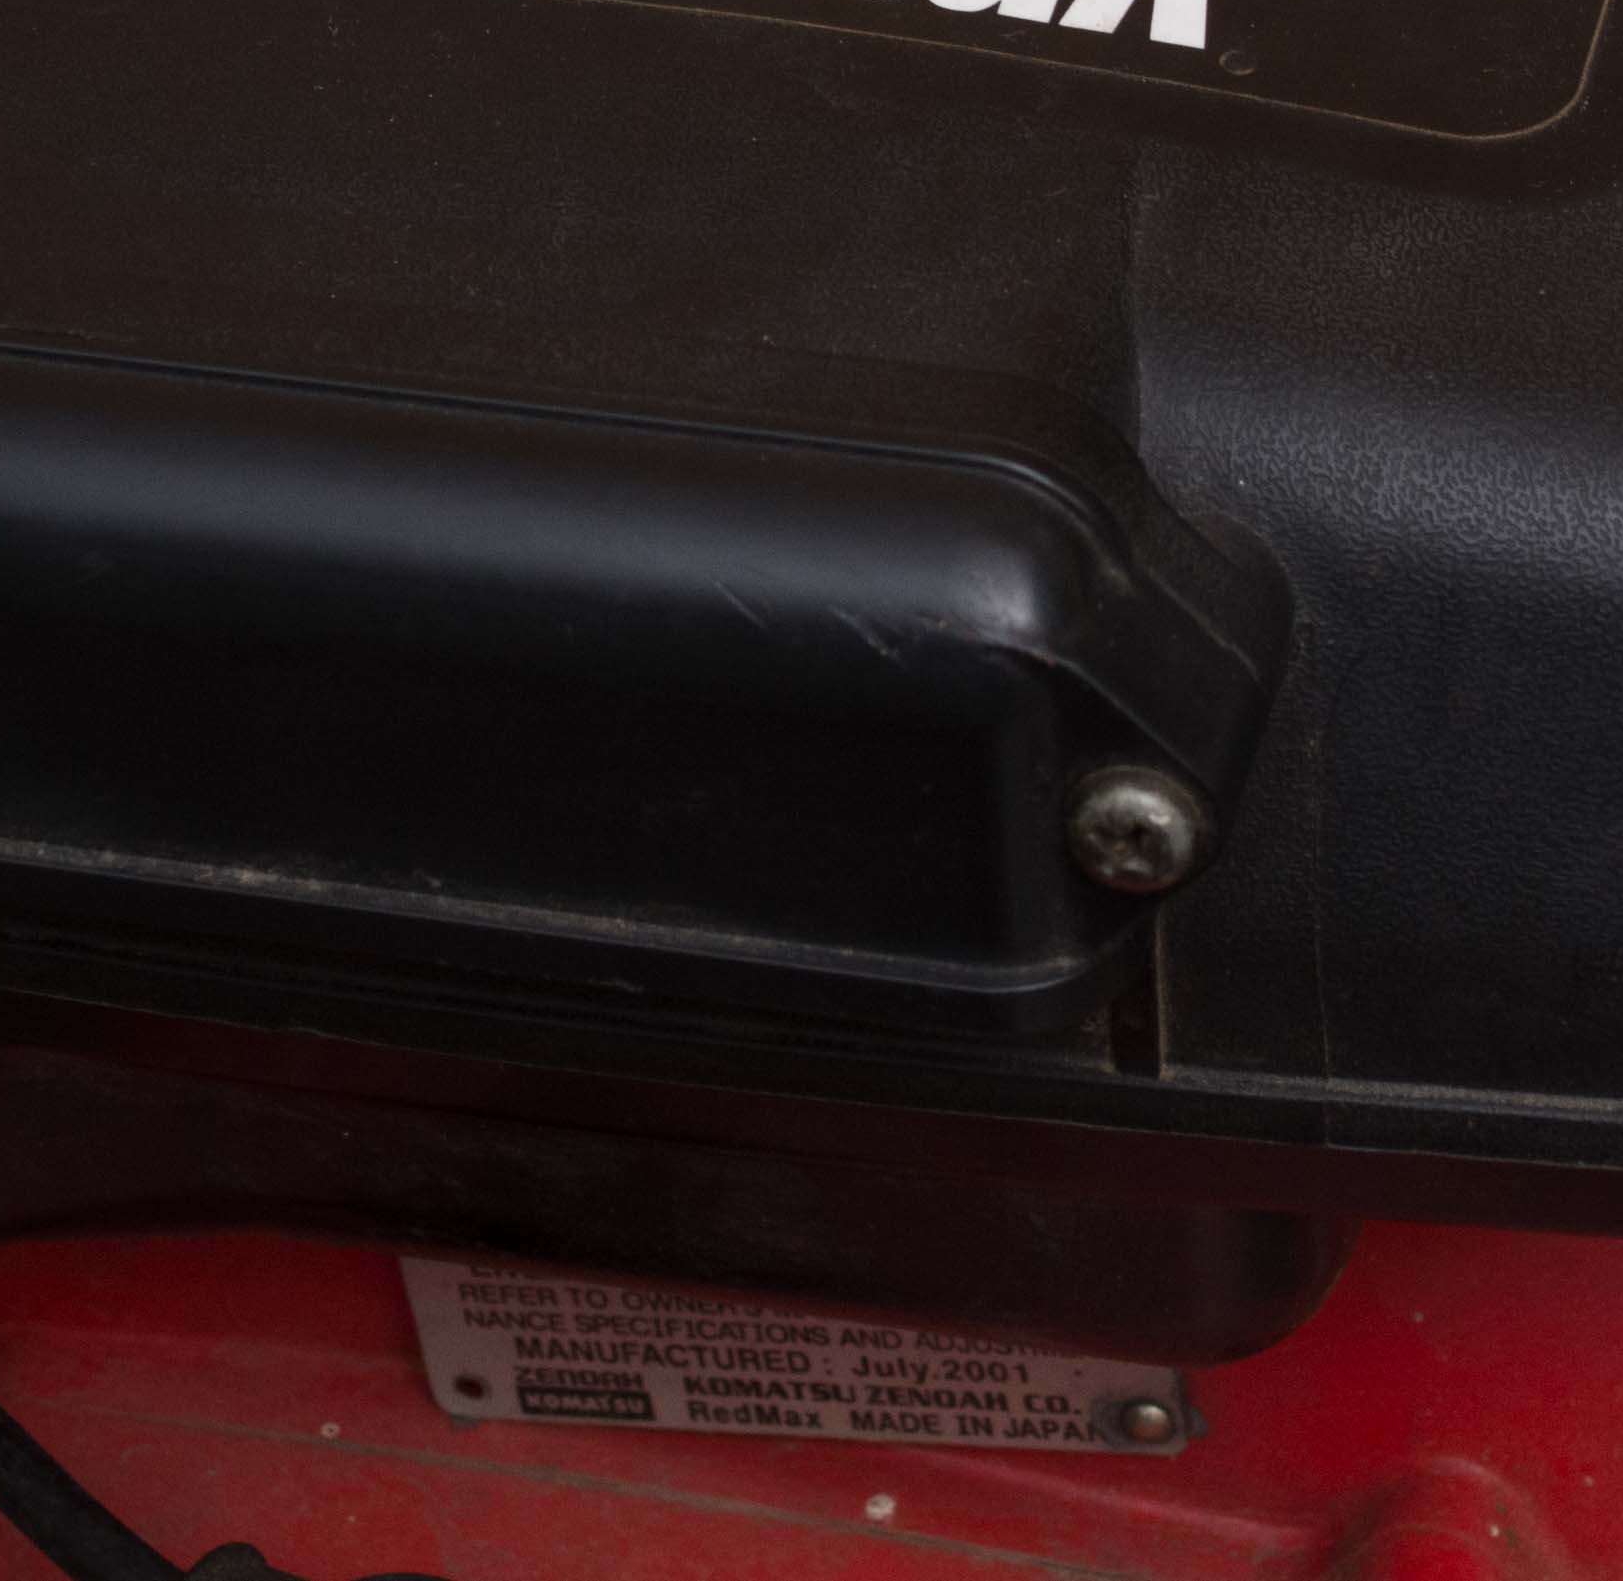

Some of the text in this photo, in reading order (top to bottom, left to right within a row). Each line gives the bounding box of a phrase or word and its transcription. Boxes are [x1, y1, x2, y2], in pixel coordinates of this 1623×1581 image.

[457, 1283, 558, 1307] REFER
[565, 1287, 608, 1310] TO
[463, 1308, 566, 1333] NANCE
[575, 1313, 831, 1348] SPECIFICATIONS
[839, 1328, 902, 1350] AND
[513, 1335, 811, 1373] MANUFACTURED
[526, 1395, 648, 1416] KOMATSU
[683, 1375, 1082, 1416] KOMATSU ZENOAH CO.
[686, 1400, 822, 1429] RedMax
[849, 1410, 943, 1435] MADE
[955, 1415, 994, 1437] IN
